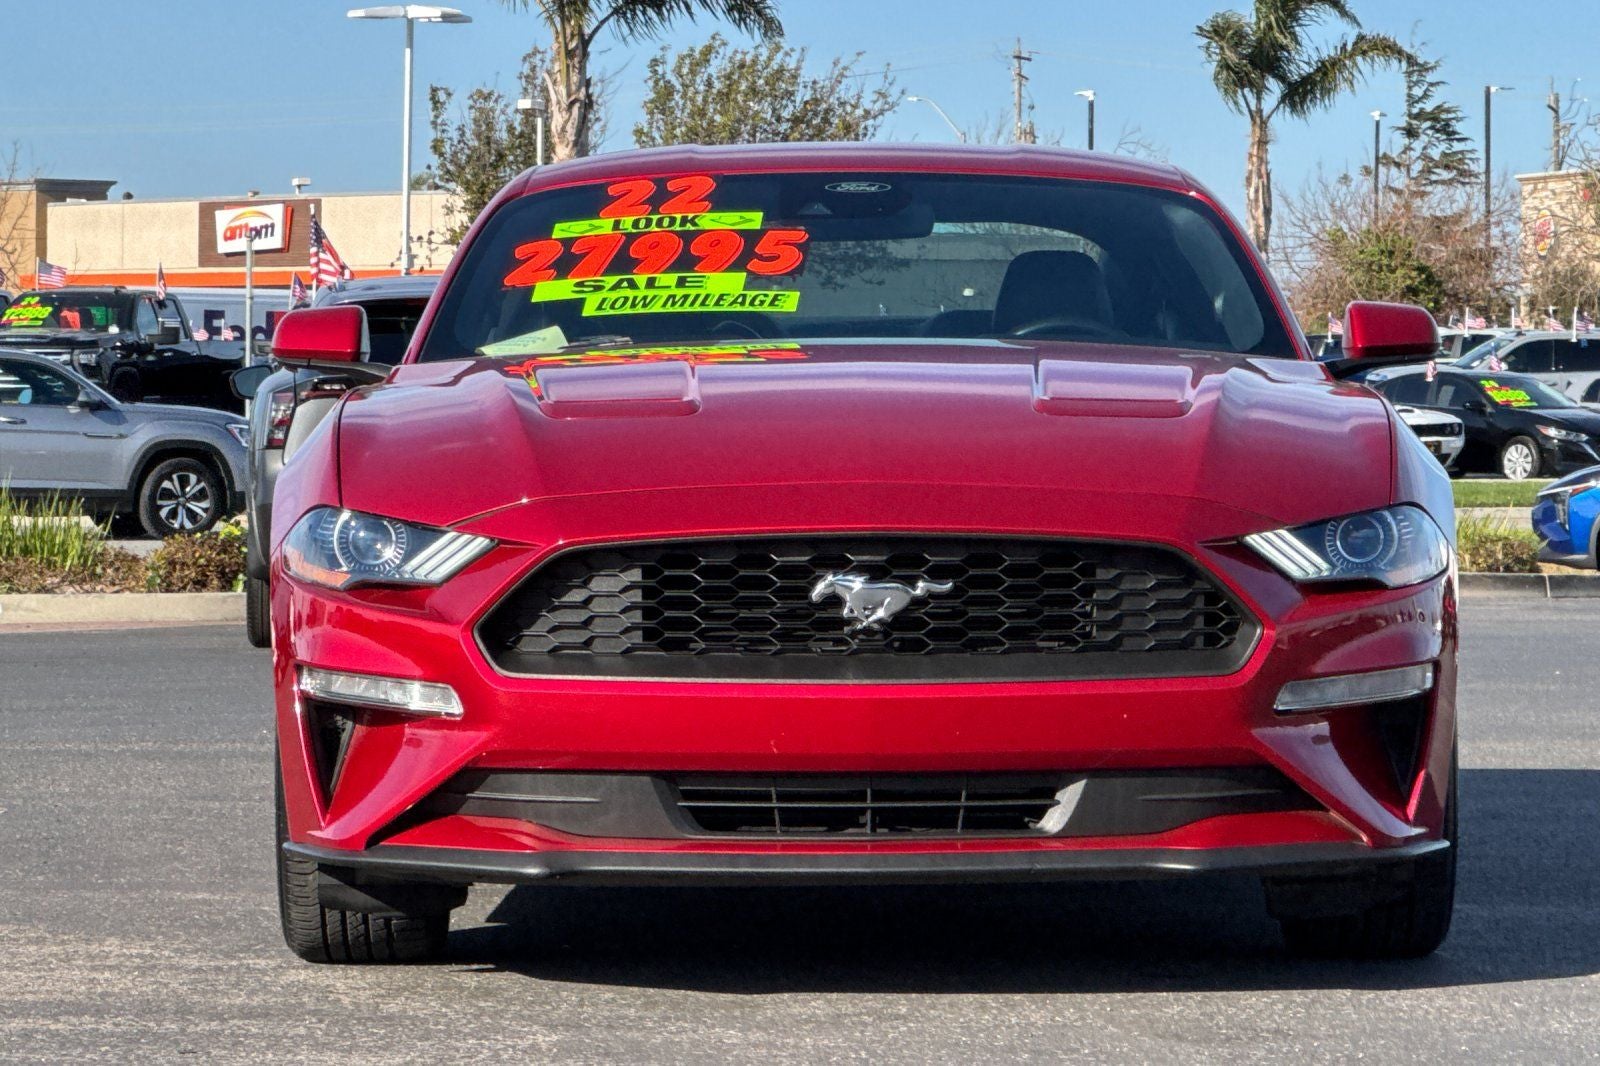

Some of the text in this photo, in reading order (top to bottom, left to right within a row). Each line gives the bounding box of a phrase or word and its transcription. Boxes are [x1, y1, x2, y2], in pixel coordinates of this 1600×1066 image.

[600, 175, 716, 218] 22
[611, 209, 702, 232] LOOK
[503, 230, 809, 287] 27995
[571, 275, 708, 295] SALE
[595, 292, 786, 312] LOW MILEAGE
